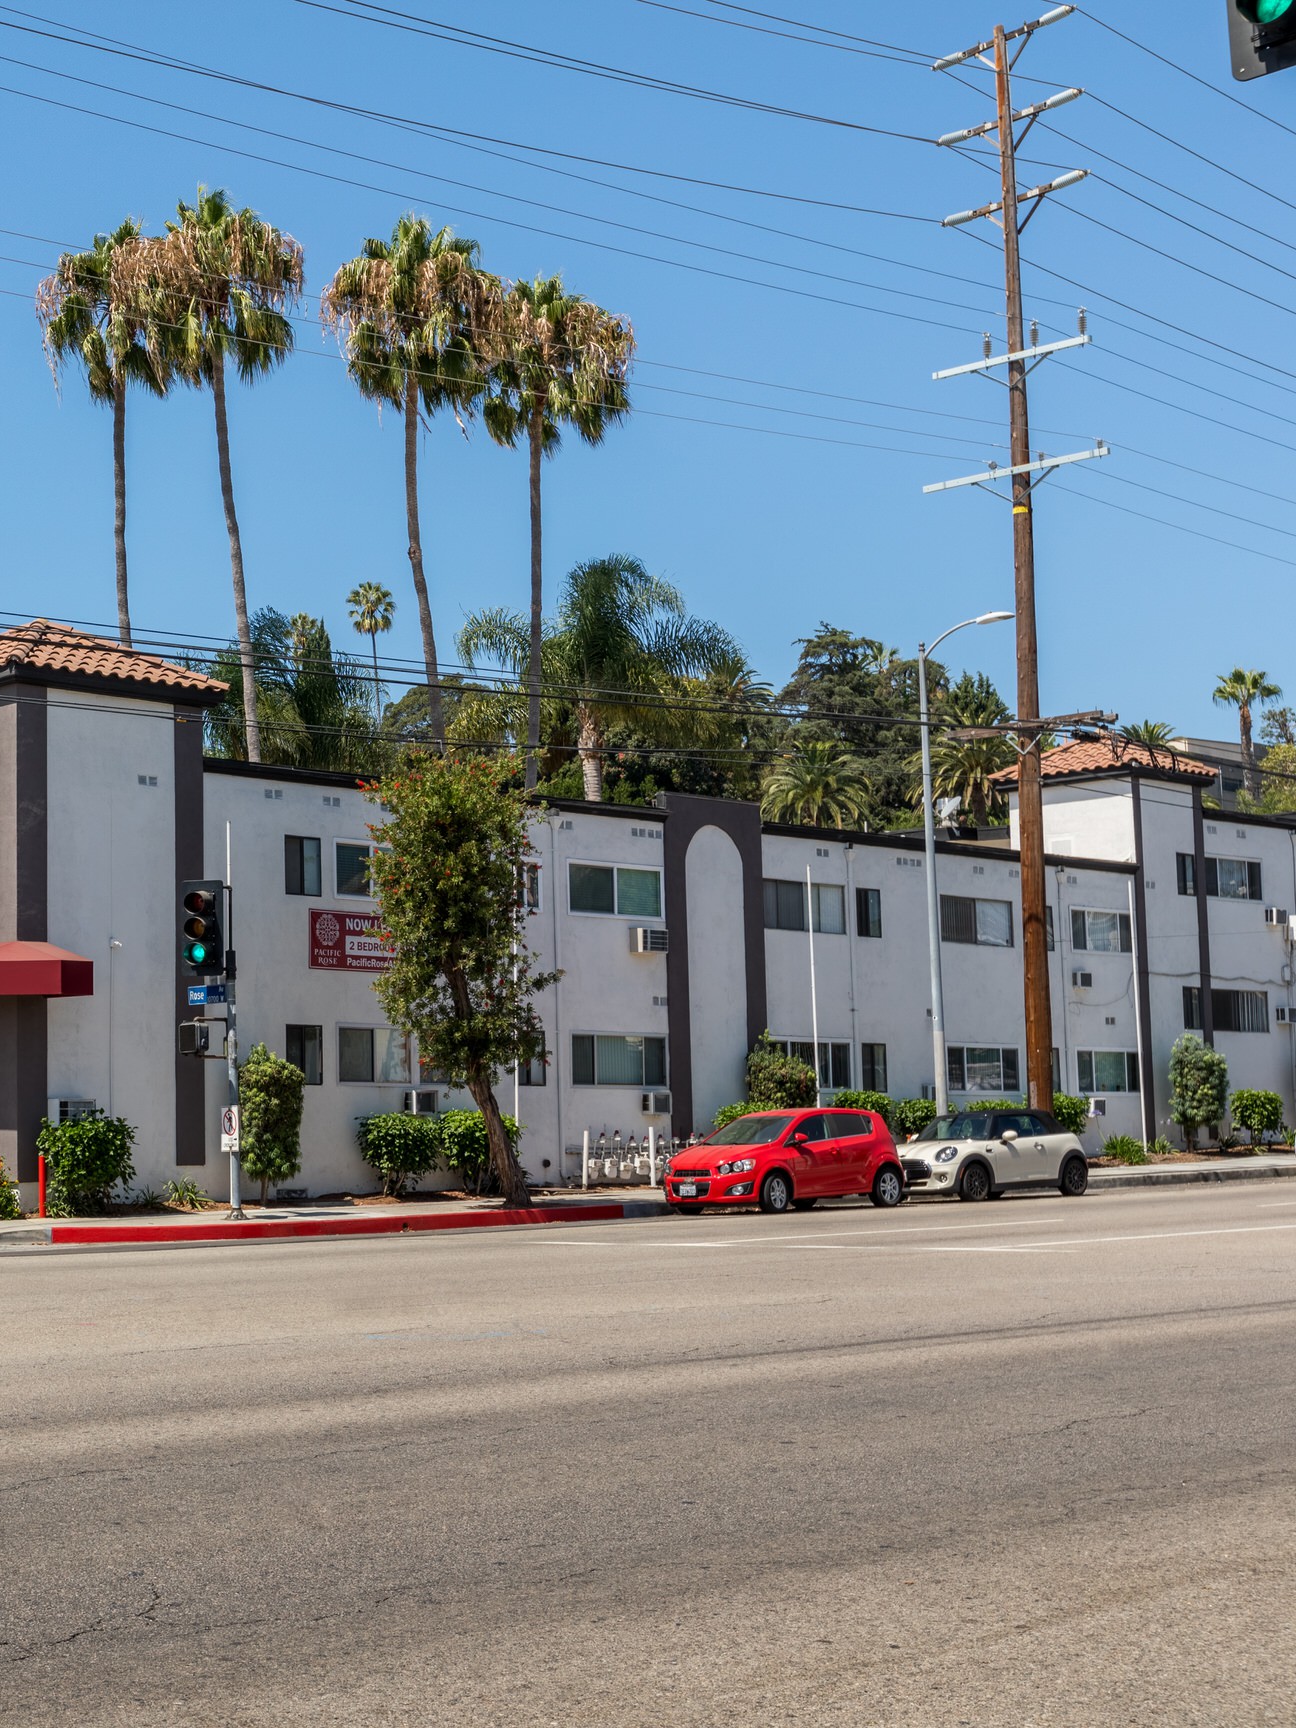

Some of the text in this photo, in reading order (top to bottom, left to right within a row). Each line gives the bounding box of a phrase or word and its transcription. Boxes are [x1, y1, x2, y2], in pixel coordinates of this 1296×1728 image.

[345, 918, 372, 931] NOW
[314, 948, 342, 957] PACIFIC
[349, 941, 395, 953] 2 BEDRO
[318, 957, 338, 966] ROSE
[190, 990, 204, 1001] Rose
